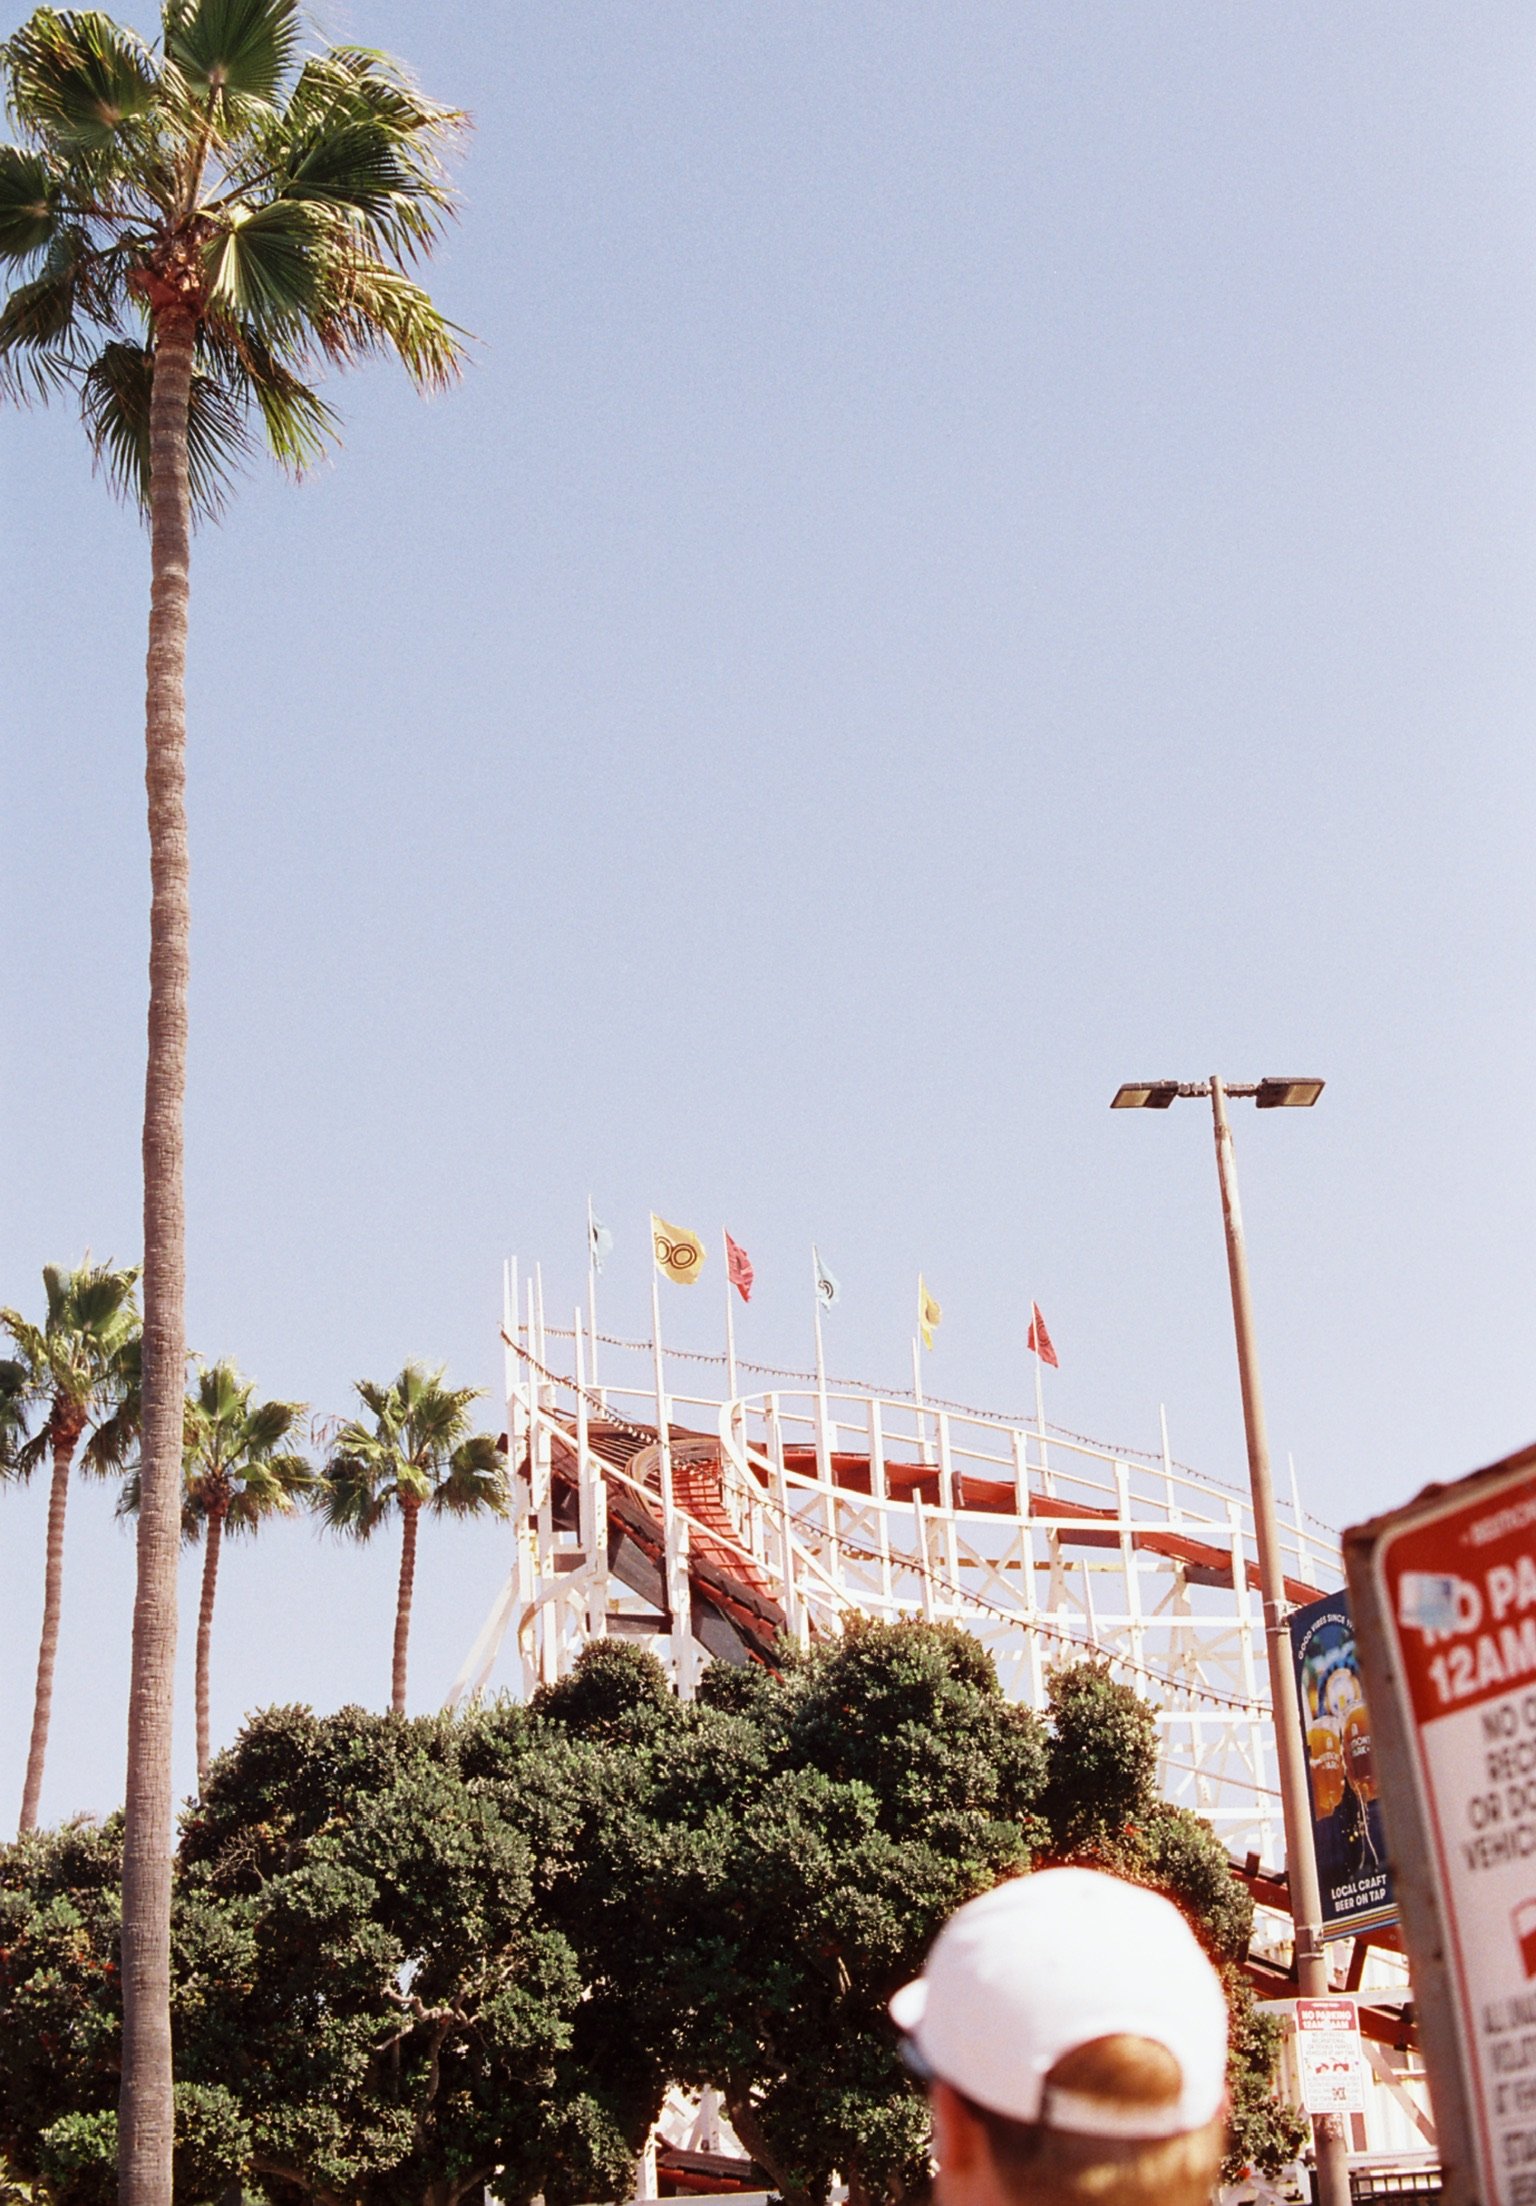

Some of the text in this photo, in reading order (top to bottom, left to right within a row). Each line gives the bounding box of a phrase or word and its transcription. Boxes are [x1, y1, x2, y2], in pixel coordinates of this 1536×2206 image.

[1298, 1630, 1312, 1660] GOOD
[1327, 1614, 1345, 1624] SINCE
[1331, 1874, 1387, 1900] LOCAL CRAFT
[1335, 1888, 1386, 1912] BEER ON TAP
[1301, 2010, 1352, 2021] NO PARKING
